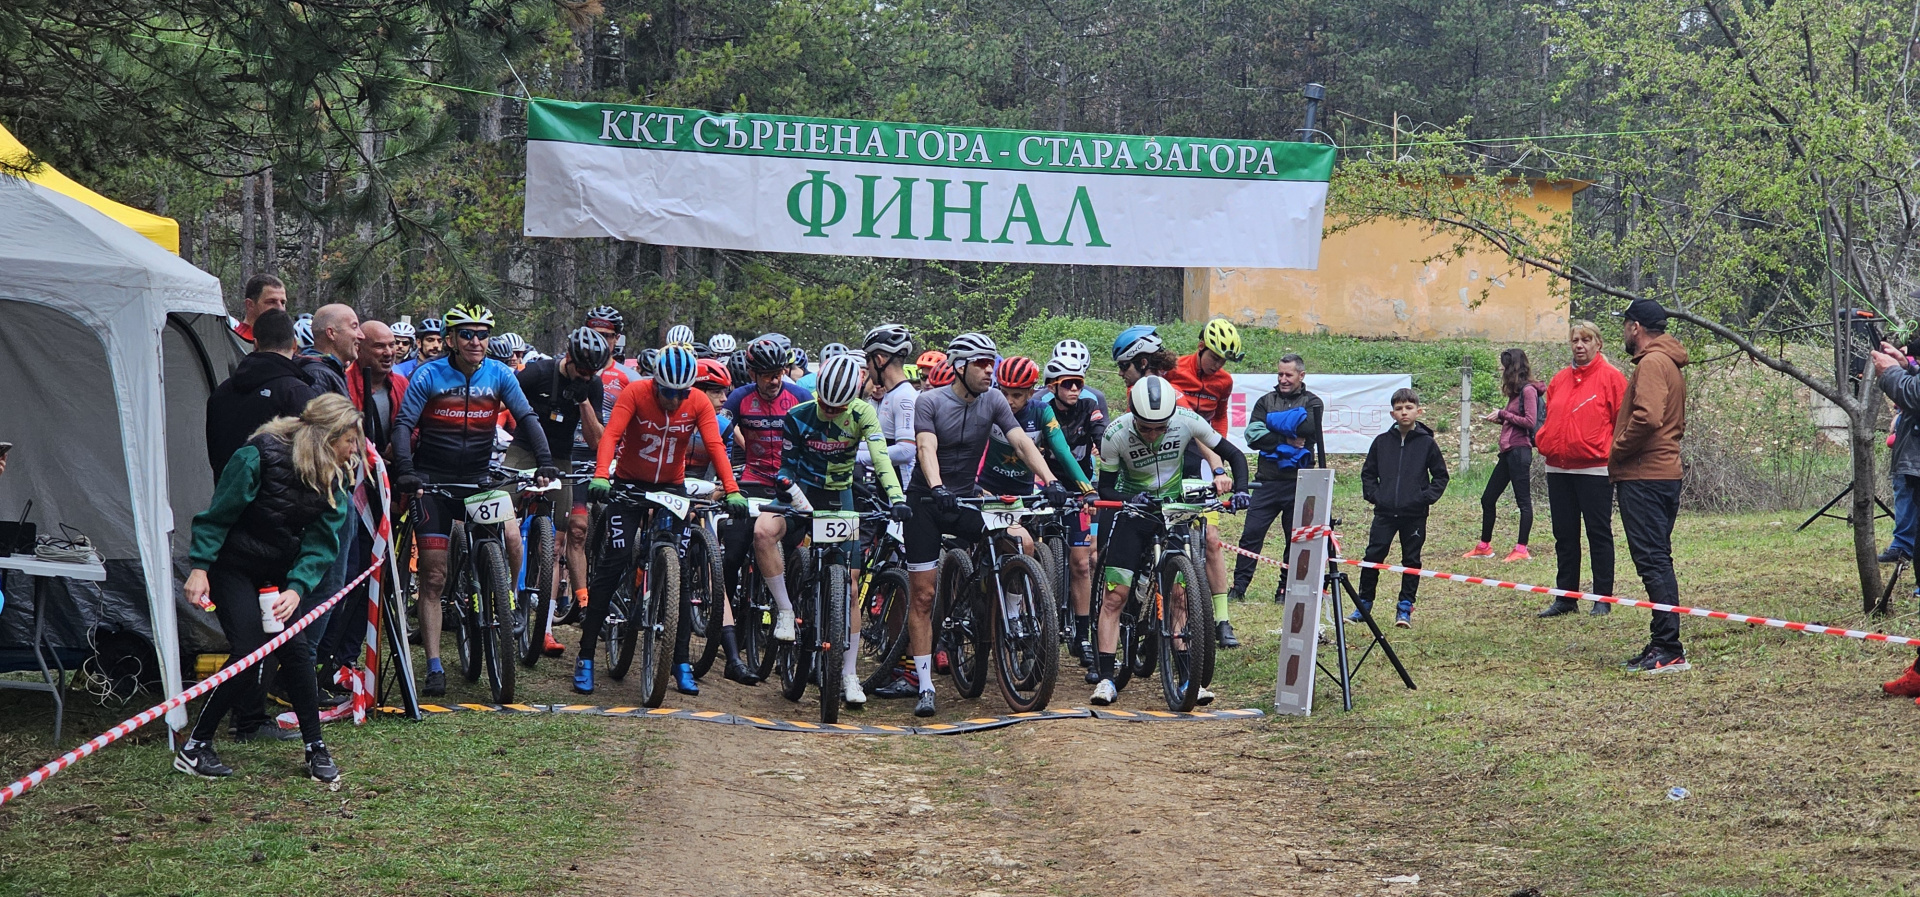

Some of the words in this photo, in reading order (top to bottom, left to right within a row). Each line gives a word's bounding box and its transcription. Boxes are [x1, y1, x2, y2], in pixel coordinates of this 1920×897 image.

[598, 109, 684, 144] ККТ
[693, 116, 888, 157] СЪРНЕНА
[894, 128, 993, 163] ГОРА
[1018, 136, 1138, 170] СТАРА
[1144, 140, 1278, 176] ЗАГОРА
[786, 169, 1112, 248] ФИНАЛ
[440, 386, 495, 397] VEREYA
[434, 408, 494, 418] velomasters
[638, 433, 678, 464] 21
[808, 440, 846, 451] VITOSHA
[1135, 453, 1162, 467] cycling
[1162, 452, 1178, 460] club
[656, 494, 683, 511] 09
[479, 502, 500, 521] 87
[610, 515, 626, 549] UAE
[825, 522, 847, 538] 52
